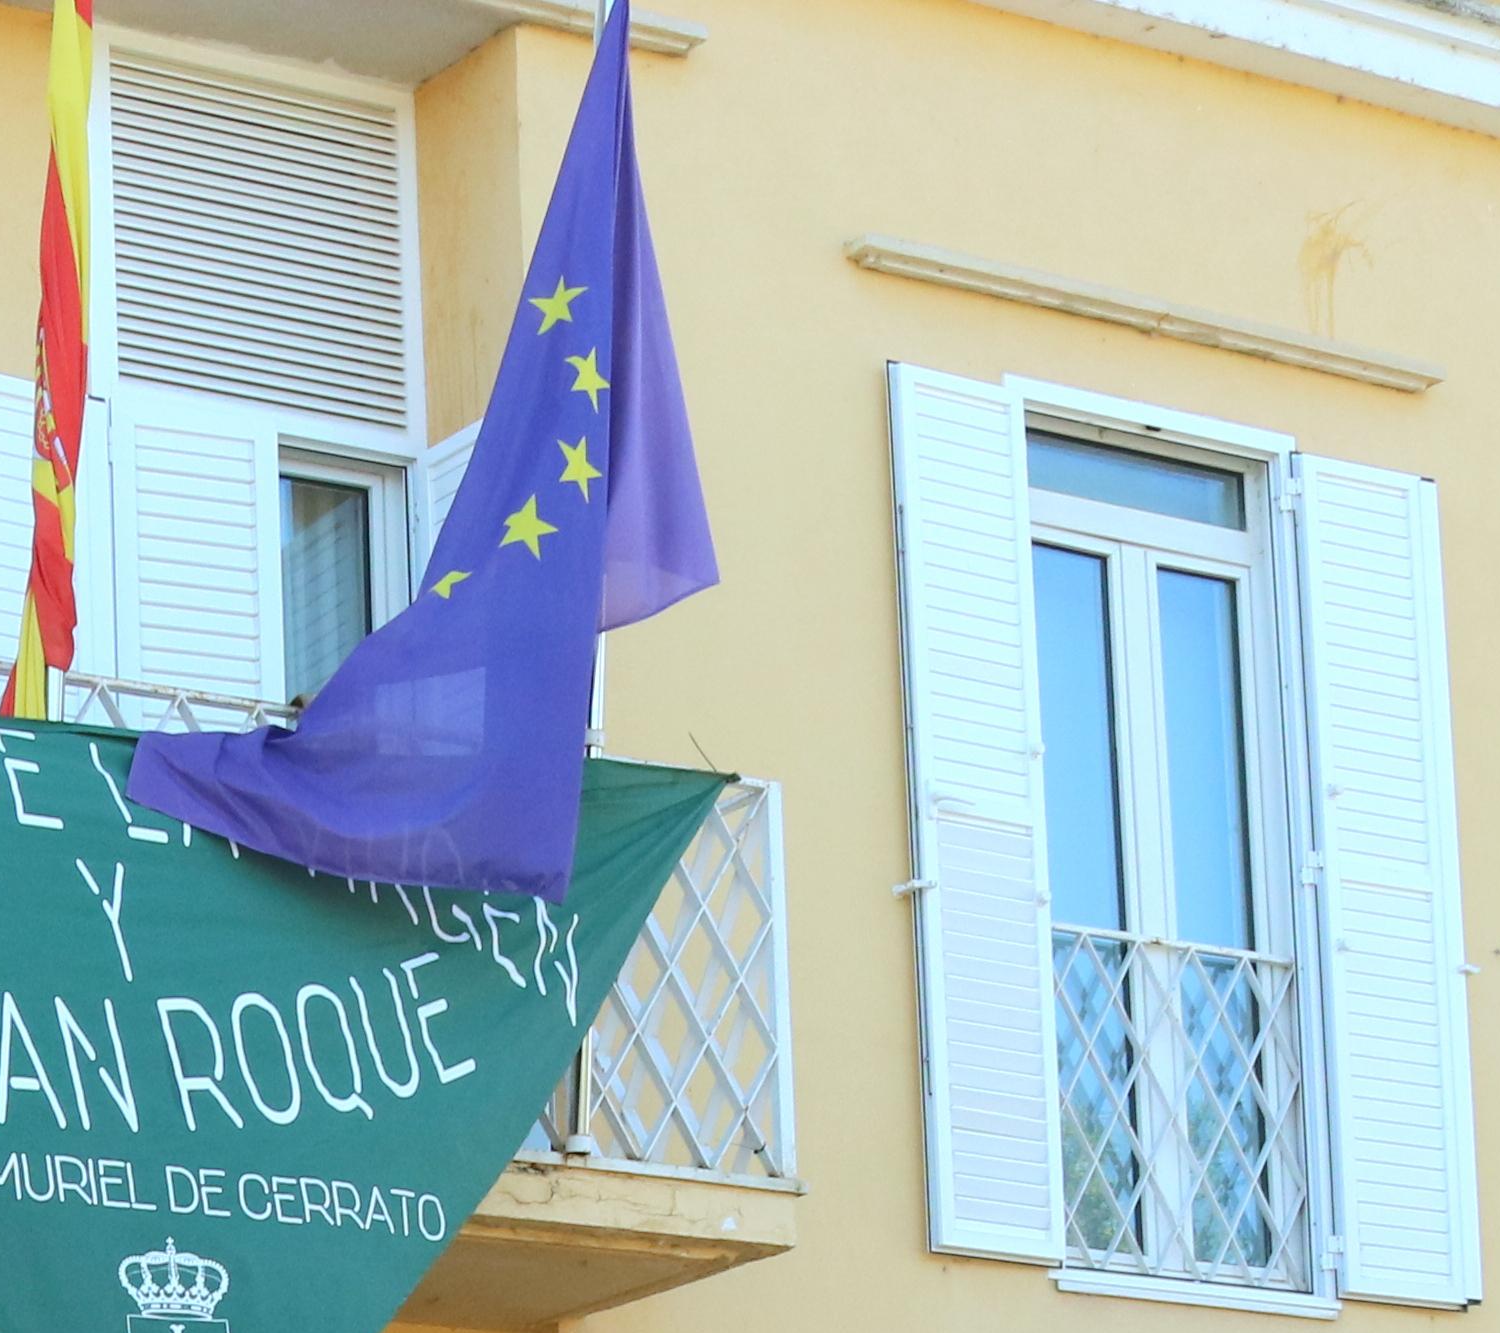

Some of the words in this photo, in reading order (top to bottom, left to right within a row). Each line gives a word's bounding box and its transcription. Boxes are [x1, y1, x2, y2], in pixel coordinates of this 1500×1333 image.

[75, 858, 134, 983] Y
[156, 951, 476, 1134] ROQUE
[164, 1165, 231, 1217] DE
[237, 1172, 446, 1243] CERRATO
